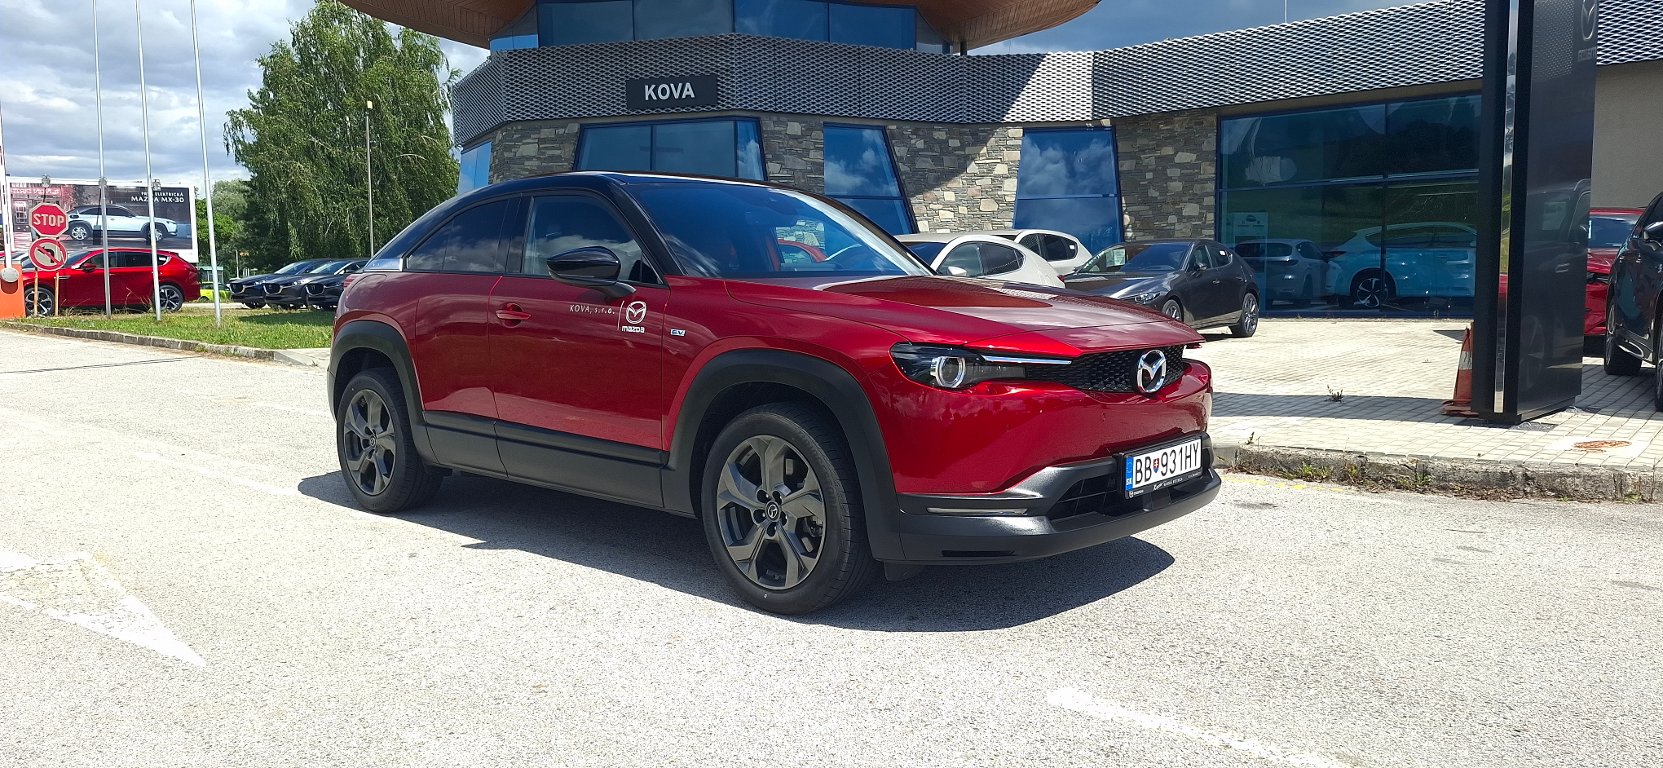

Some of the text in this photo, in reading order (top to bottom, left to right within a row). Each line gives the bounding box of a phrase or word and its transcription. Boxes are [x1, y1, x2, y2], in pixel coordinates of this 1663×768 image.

[644, 82, 695, 101] KOVA
[33, 213, 65, 227] STOP
[569, 304, 616, 315] KOVA, s.r.o.
